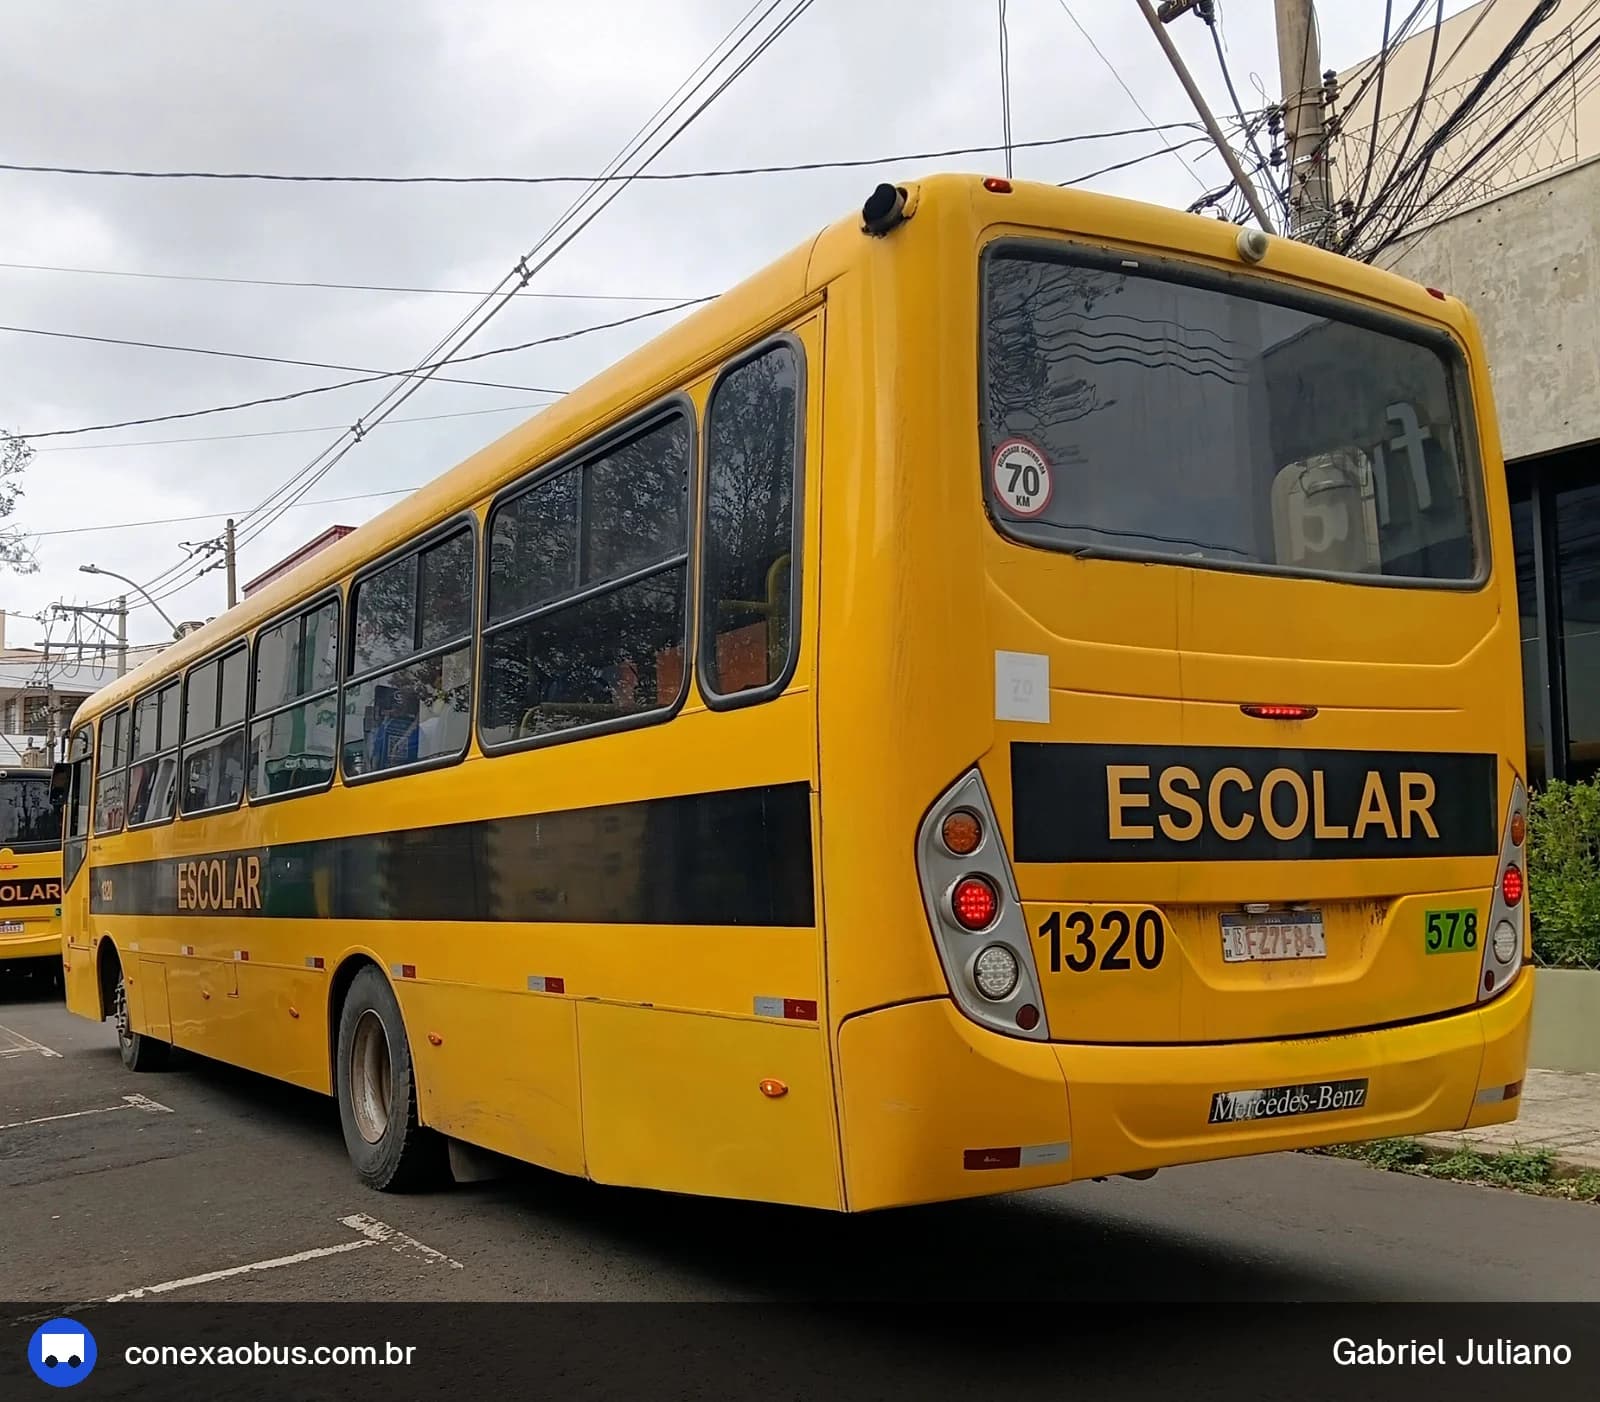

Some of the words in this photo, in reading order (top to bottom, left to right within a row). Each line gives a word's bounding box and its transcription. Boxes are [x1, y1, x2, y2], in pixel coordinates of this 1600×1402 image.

[1005, 463, 1040, 496] 70
[1015, 495, 1031, 507] KM
[1106, 764, 1440, 842] ESCOLAR
[177, 856, 261, 910] ESCOLAR
[1038, 909, 1165, 974] 1320
[1425, 912, 1478, 951] 578
[1211, 1085, 1365, 1122] Mercedes-Benz
